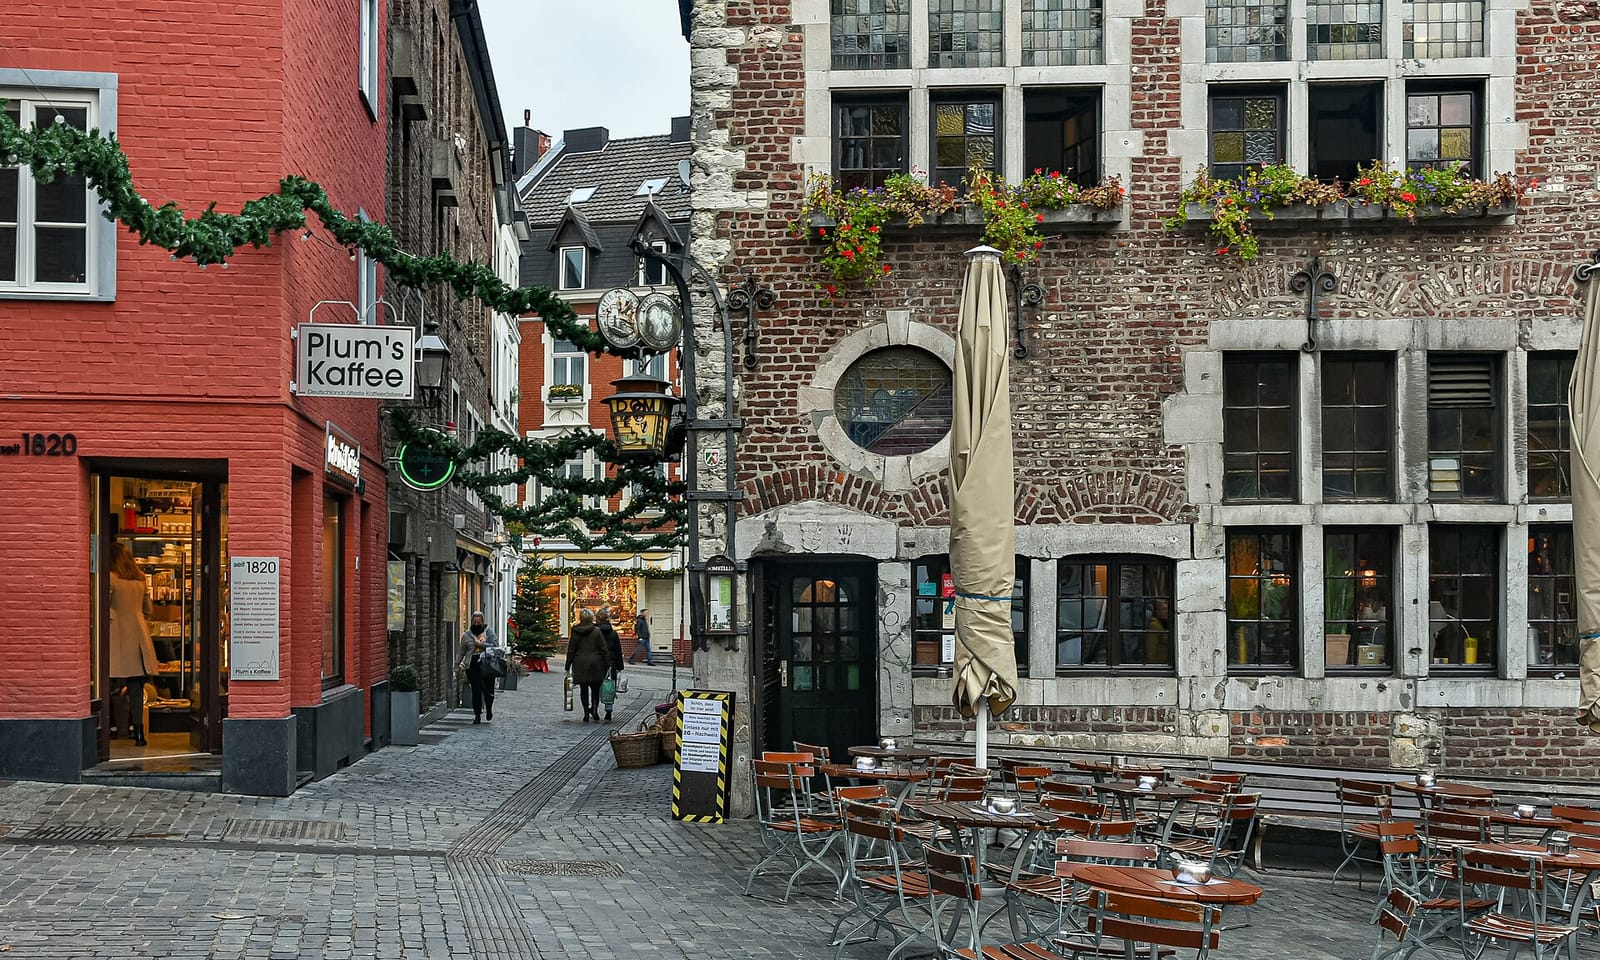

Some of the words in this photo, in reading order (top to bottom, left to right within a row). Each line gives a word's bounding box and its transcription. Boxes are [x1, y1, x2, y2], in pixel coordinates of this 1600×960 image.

[307, 332, 404, 360] Plum's
[307, 360, 404, 388] Kaffee
[22, 432, 77, 456] 1820
[246, 561, 276, 574] 1820
